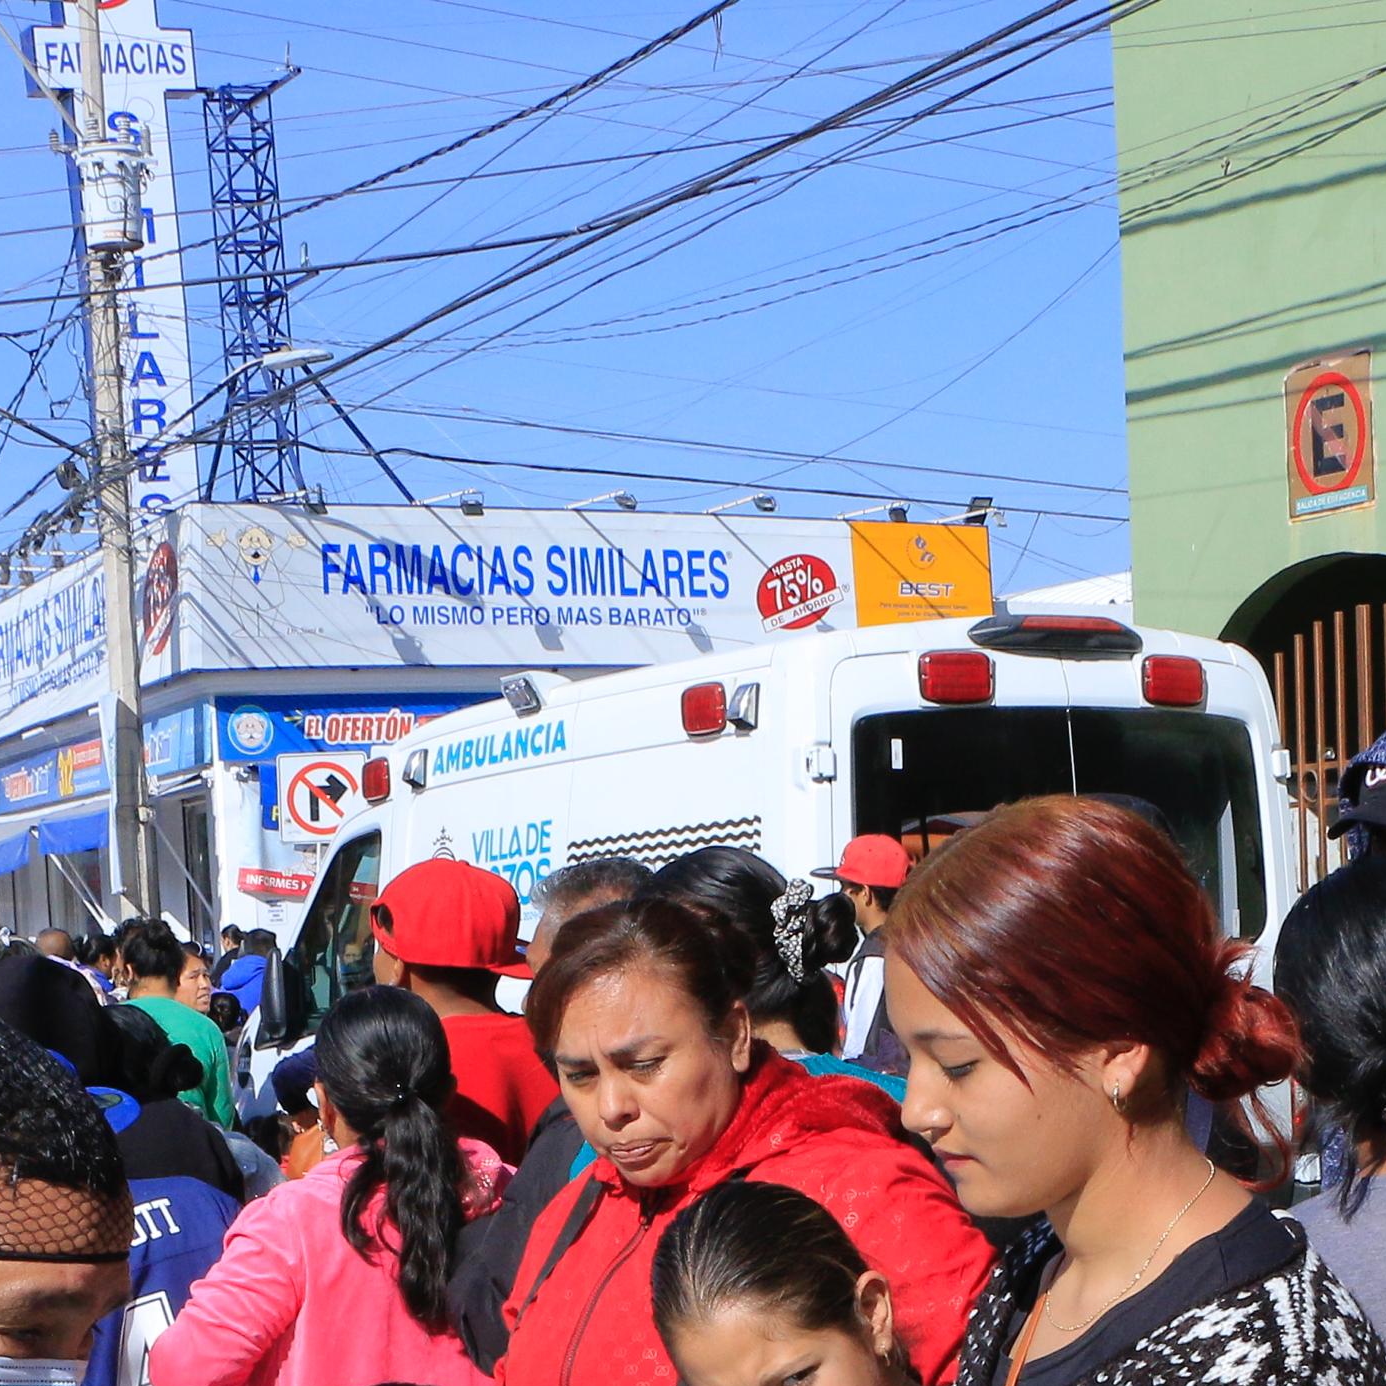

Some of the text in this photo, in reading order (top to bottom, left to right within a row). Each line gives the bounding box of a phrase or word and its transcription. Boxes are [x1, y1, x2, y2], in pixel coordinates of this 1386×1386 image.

[321, 543, 730, 600] FARMACIAS SIMILARES
[771, 556, 805, 577] HASTA
[766, 564, 825, 611] 75%
[898, 581, 955, 598] BEST
[412, 605, 485, 626] MISMO
[492, 606, 551, 626] PERO
[558, 606, 602, 626] MAS
[770, 593, 837, 628] DE AHORRO
[305, 709, 413, 743] EL OFERTÓN
[432, 720, 567, 776] AMBULANCIA
[471, 819, 553, 864] VILLA DE
[245, 874, 300, 890] INFORMES
